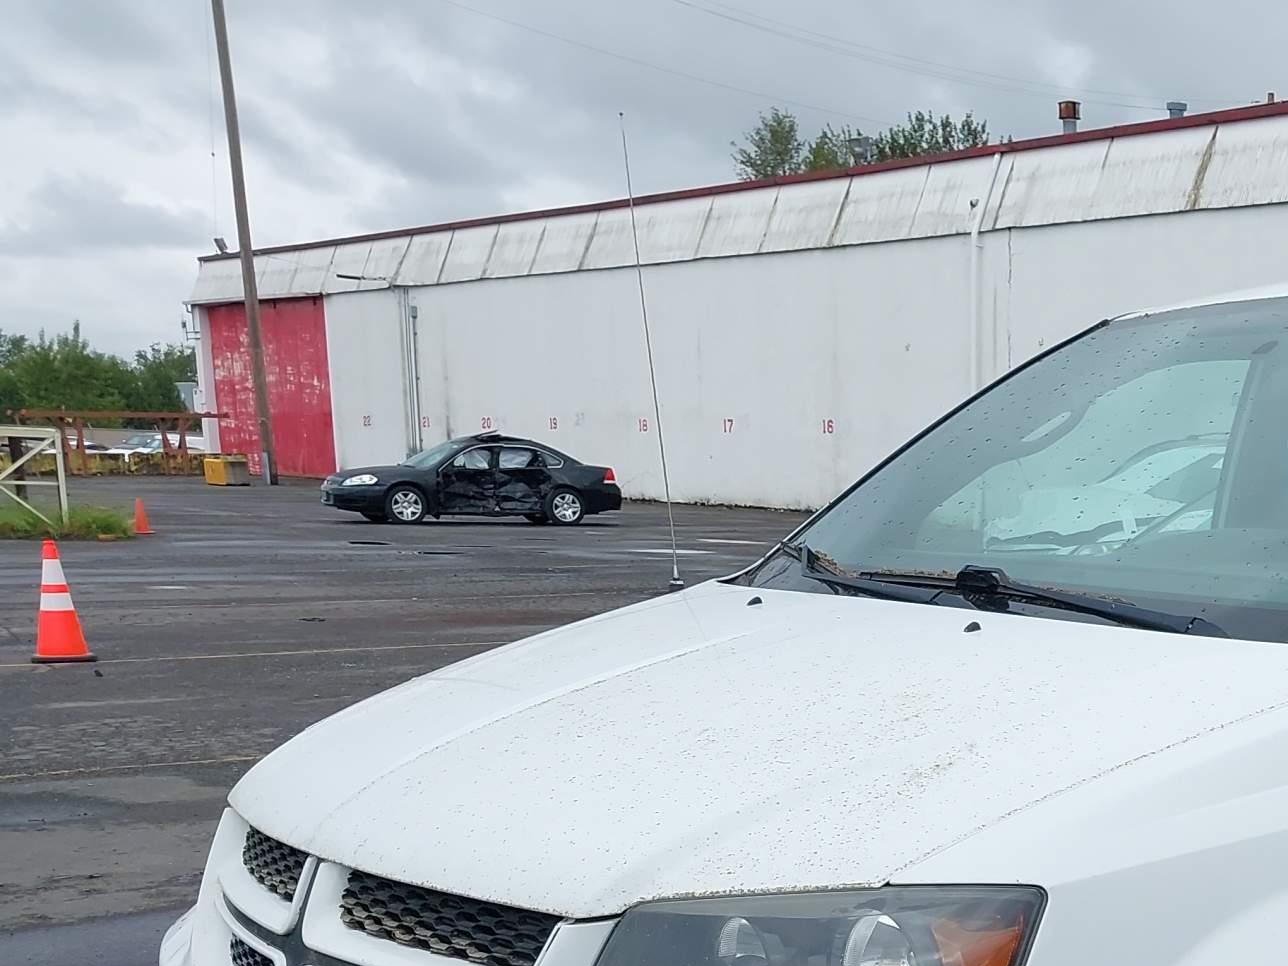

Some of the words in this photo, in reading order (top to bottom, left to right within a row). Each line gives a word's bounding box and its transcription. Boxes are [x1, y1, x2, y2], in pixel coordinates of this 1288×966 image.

[362, 415, 372, 427] 22
[422, 415, 430, 428] 21
[481, 416, 492, 429] 20
[549, 416, 558, 430] 19
[638, 418, 648, 432] 18
[723, 418, 734, 433] 17
[822, 419, 834, 434] 16
